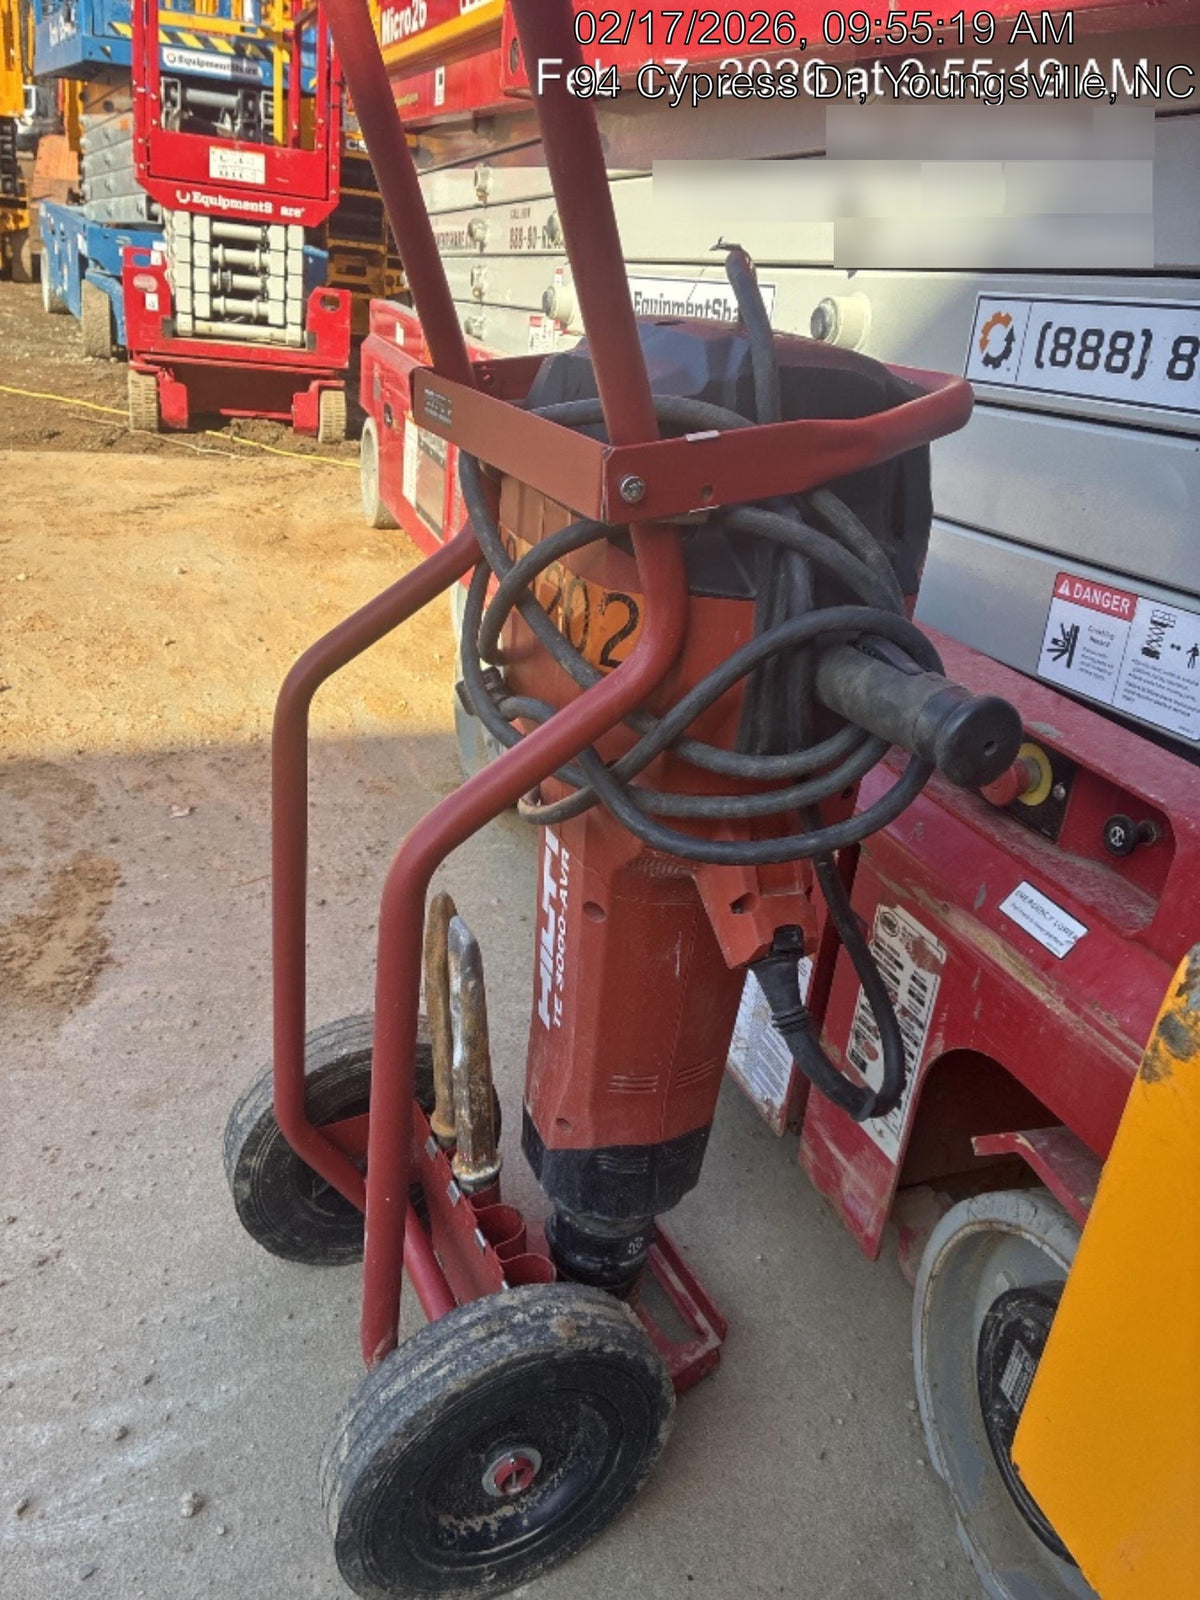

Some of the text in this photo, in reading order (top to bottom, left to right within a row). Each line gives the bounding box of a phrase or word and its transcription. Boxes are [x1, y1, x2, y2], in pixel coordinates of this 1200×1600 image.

[1034, 321, 1153, 380] (888)
[1073, 583, 1131, 615] DANGER
[538, 825, 560, 1031] HILTI
